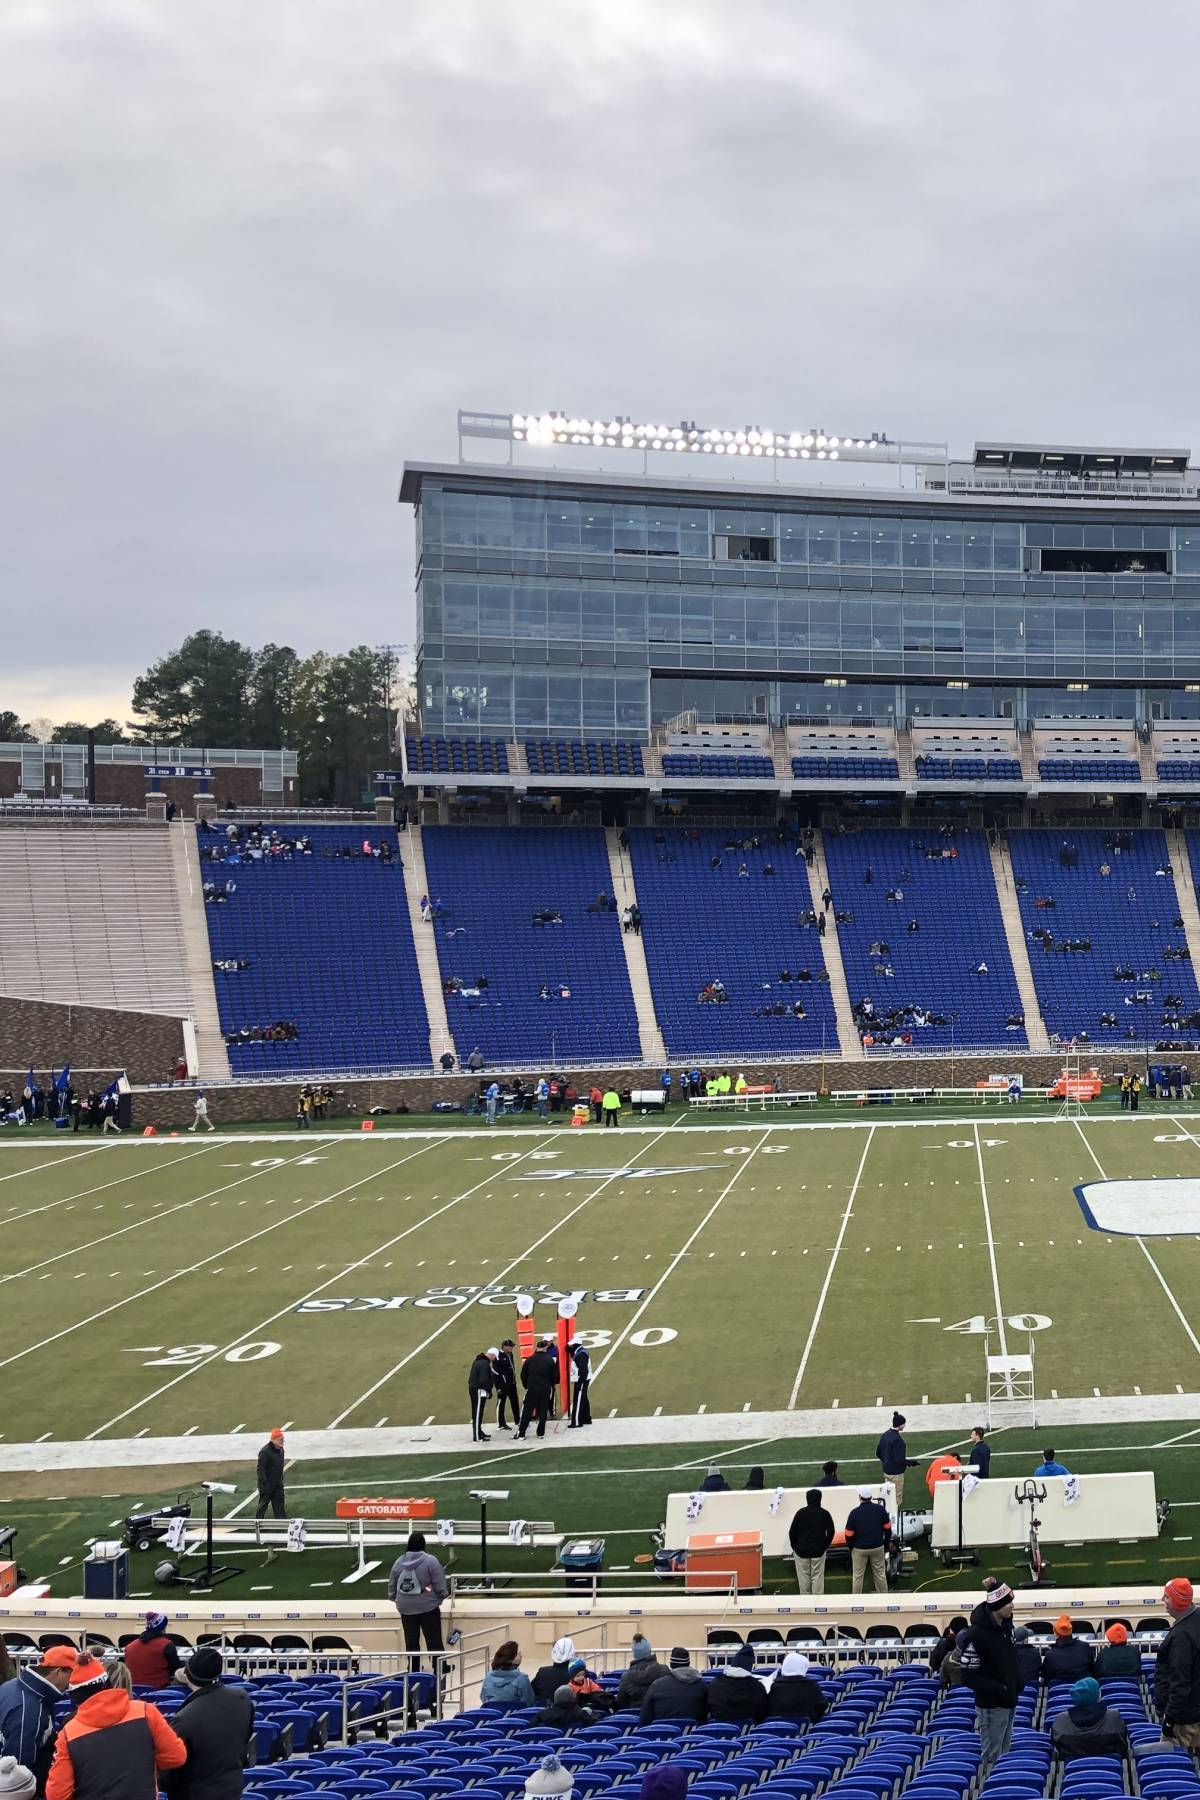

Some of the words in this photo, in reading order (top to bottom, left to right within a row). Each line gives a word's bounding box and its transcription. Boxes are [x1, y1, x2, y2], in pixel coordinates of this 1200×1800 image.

[947, 1138, 1009, 1149] 40
[424, 1283, 552, 1295] FIELD
[296, 1286, 652, 1314] BROOKS
[942, 1313, 1053, 1335] 40
[141, 1341, 283, 1367] 20
[356, 1505, 409, 1514] GATORADE
